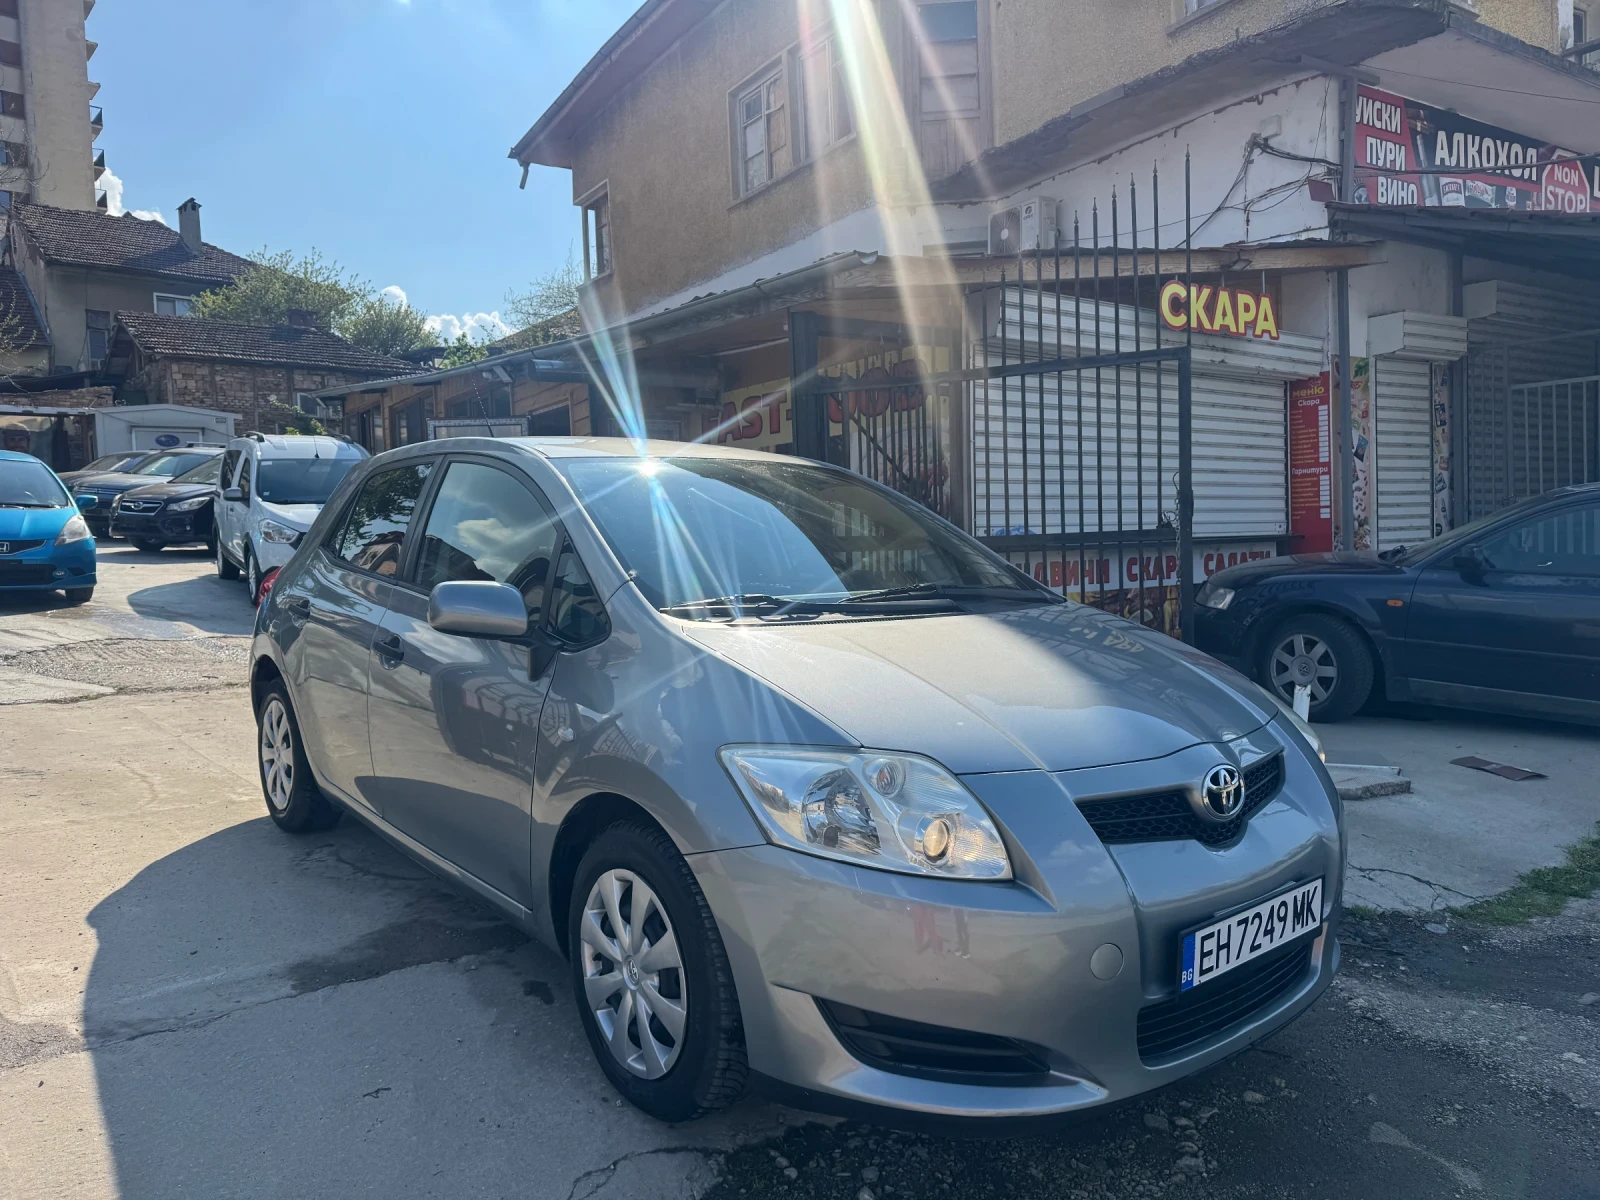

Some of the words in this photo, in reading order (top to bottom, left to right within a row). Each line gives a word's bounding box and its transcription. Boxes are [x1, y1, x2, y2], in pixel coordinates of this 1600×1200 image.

[1366, 136, 1406, 171] ПУРИ
[1434, 130, 1537, 181] АЛКОХОЛ
[1554, 164, 1579, 187] NON
[1377, 176, 1418, 205] ВИНО
[1546, 185, 1586, 213] STOP
[1160, 281, 1279, 339] СКАРА
[1291, 466, 1329, 475] Гарнитури
[1126, 555, 1178, 582] СКАР
[1181, 968, 1193, 983] BG
